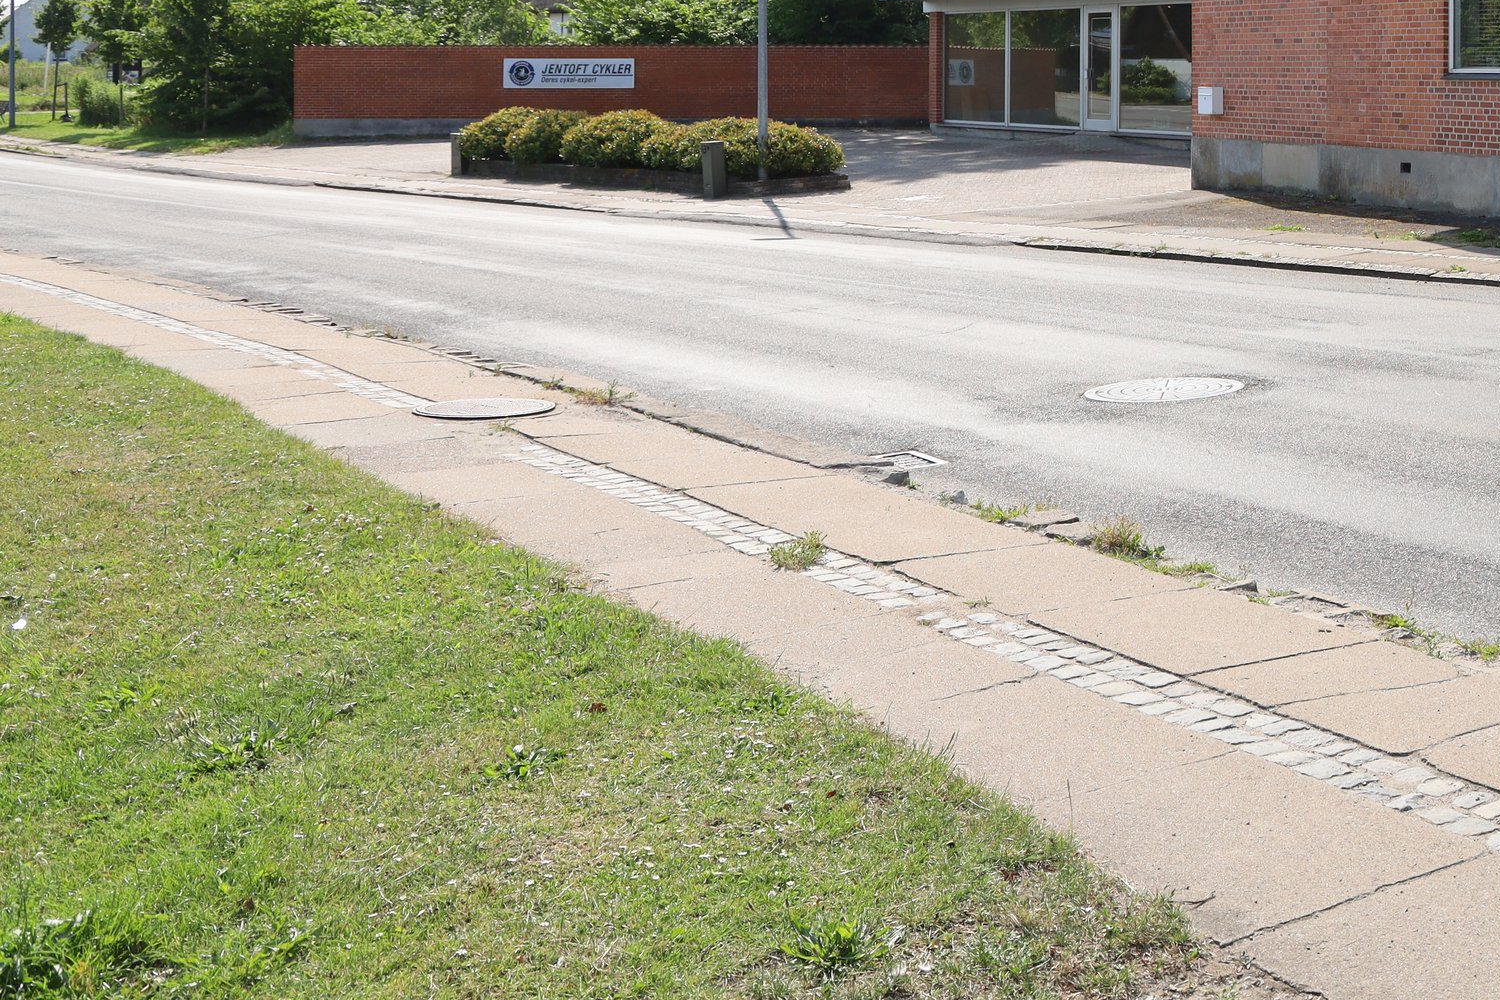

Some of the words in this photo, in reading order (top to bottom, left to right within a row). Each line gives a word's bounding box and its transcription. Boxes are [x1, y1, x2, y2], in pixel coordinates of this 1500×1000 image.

[541, 63, 589, 74] JENTOFT
[592, 63, 632, 74] CYKLER
[560, 76, 597, 84] cykel-expert
